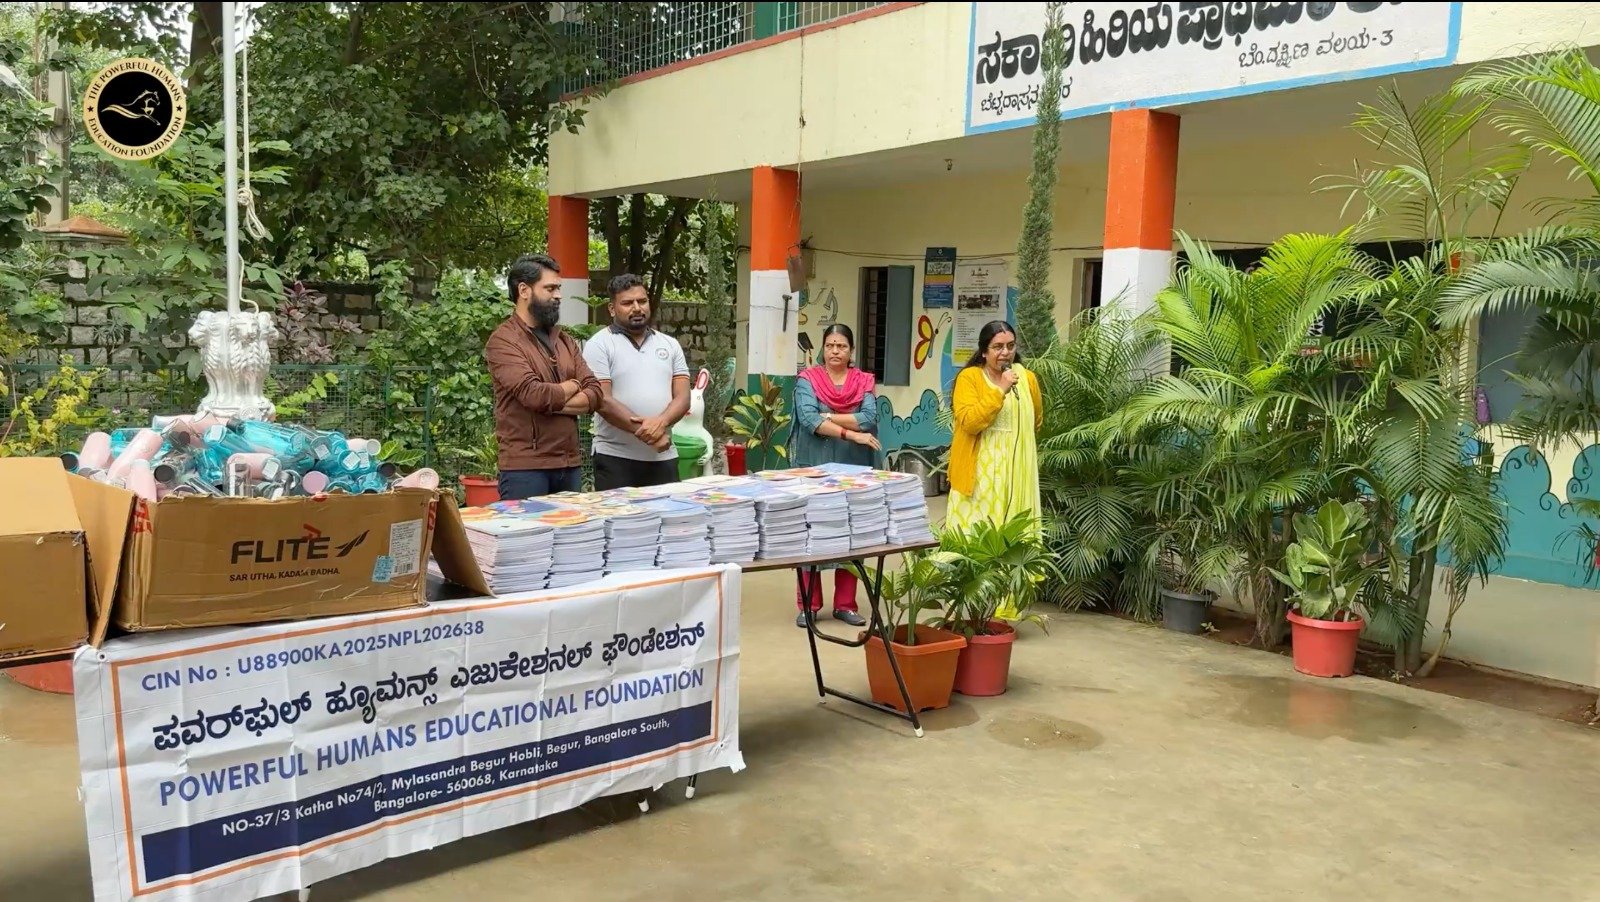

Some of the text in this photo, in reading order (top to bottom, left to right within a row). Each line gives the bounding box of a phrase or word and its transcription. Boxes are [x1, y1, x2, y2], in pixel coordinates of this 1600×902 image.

[1079, 2, 1172, 65] ಹಿರಿಯ
[229, 574, 248, 582] SAR
[230, 536, 331, 565] FLITE
[141, 669, 181, 692] CIN
[188, 665, 218, 684] No
[237, 620, 484, 675] U88900KA2025NPL202638
[450, 641, 592, 688] ಎಜುಕೇಶನಲ್
[159, 668, 704, 807] POWERFUL HUMANS EDUCATIONAL FOUNDATION
[222, 718, 671, 836] NO-37/3 Katha No74/2, Mylasandra Begur Hobli, Begur, Bangalore South,
[374, 760, 559, 813] Bangalore- 560068, Karnataka
